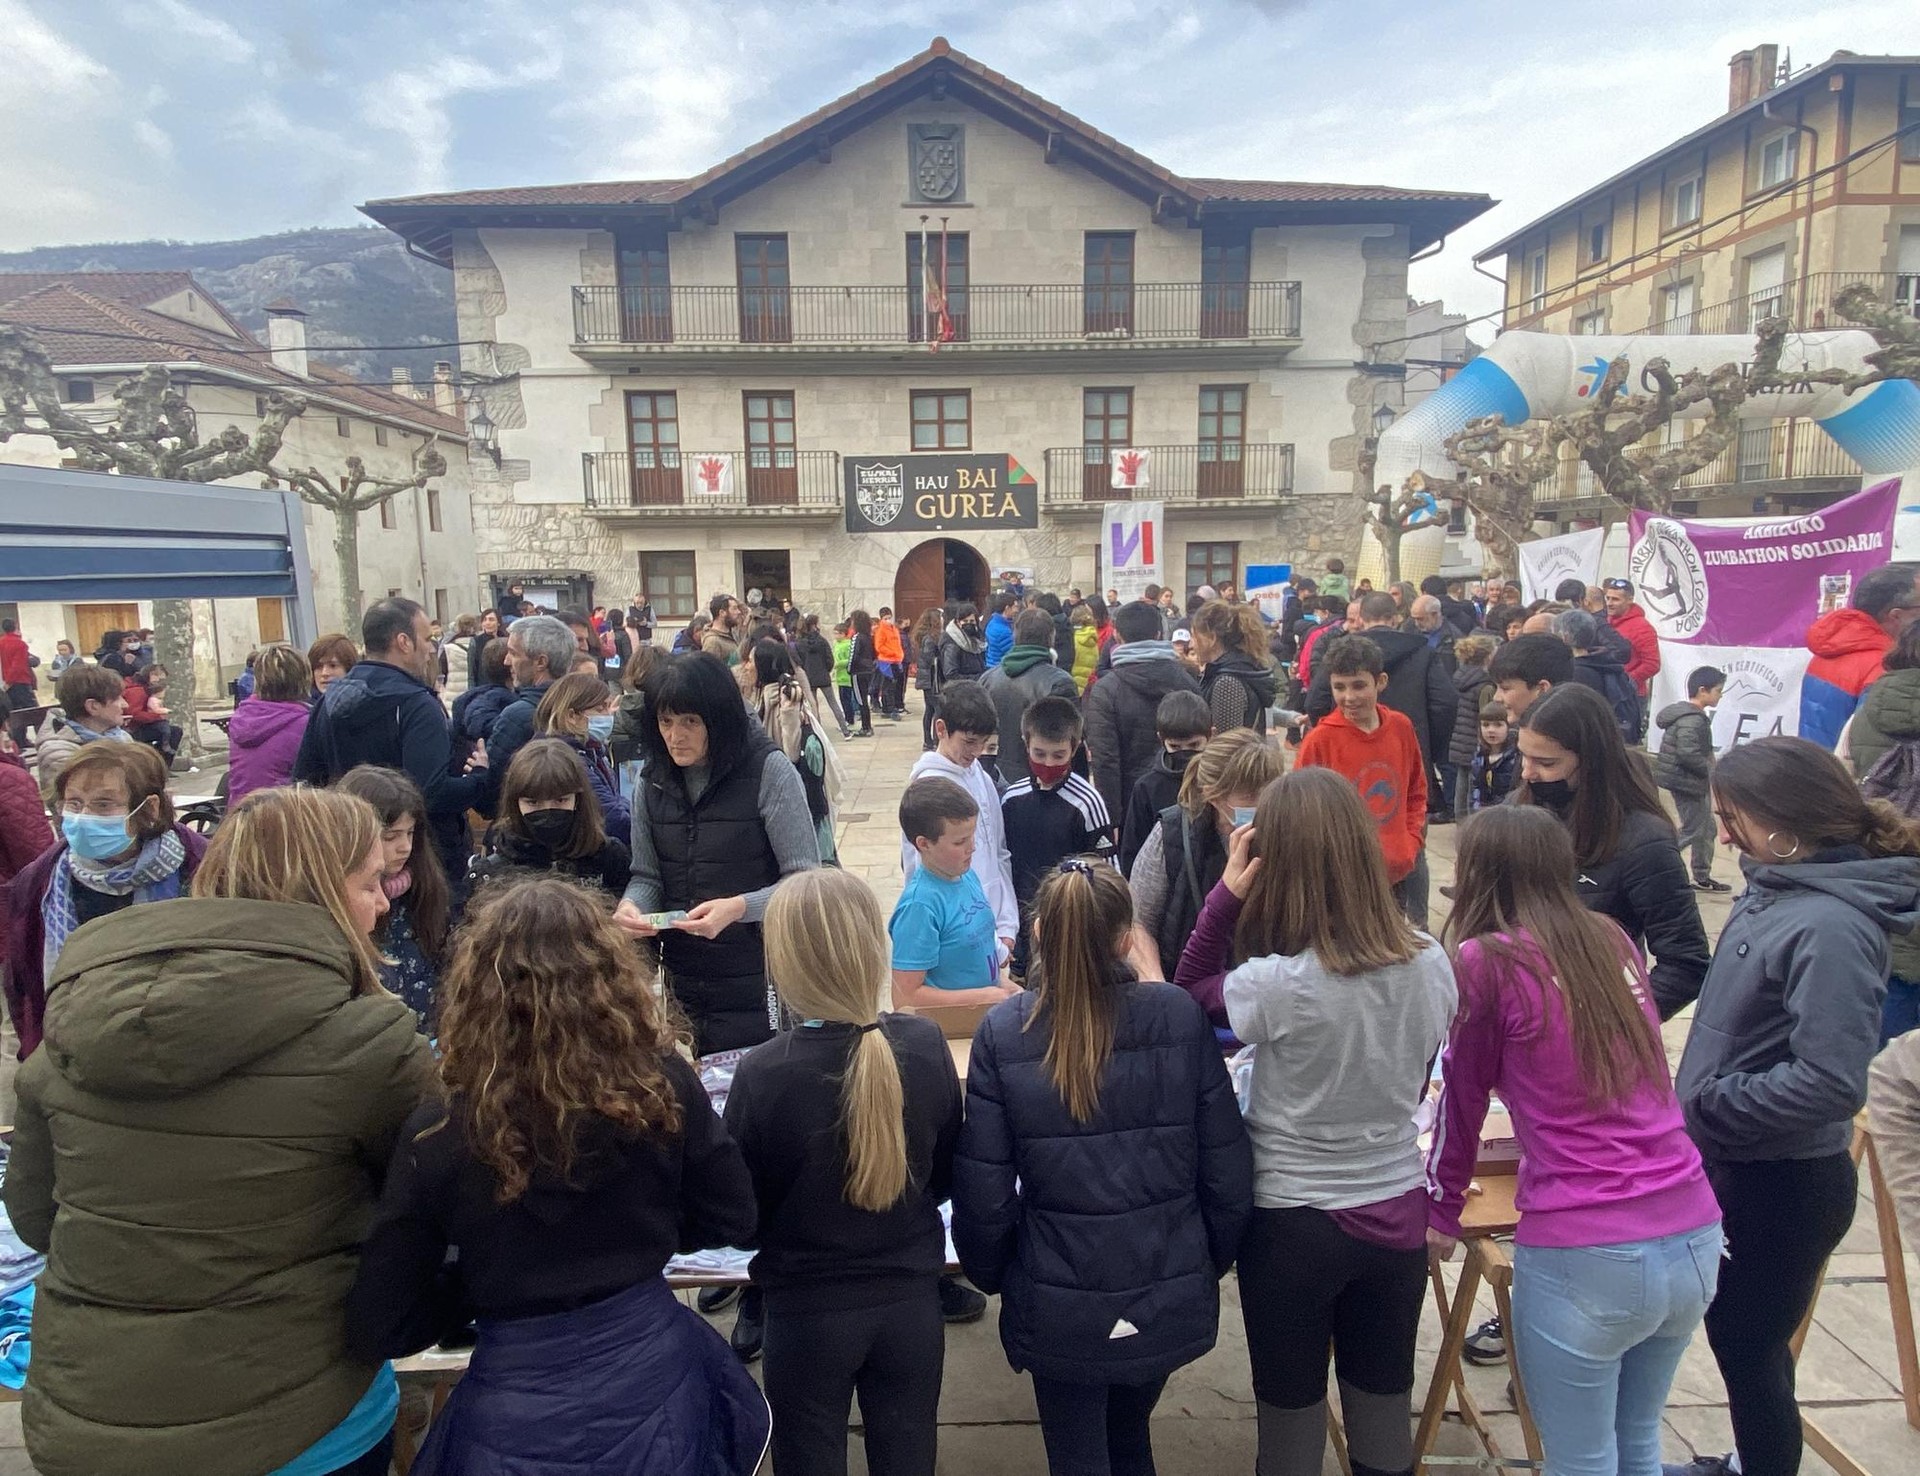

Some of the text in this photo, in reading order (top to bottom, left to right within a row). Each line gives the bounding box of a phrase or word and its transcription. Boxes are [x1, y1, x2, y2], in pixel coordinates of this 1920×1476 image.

[860, 470, 898, 478] EUSKAL
[915, 468, 997, 490] HAU BAI
[915, 492, 1021, 519] GUREA
[1704, 546, 1790, 566] ZUMBATHON
